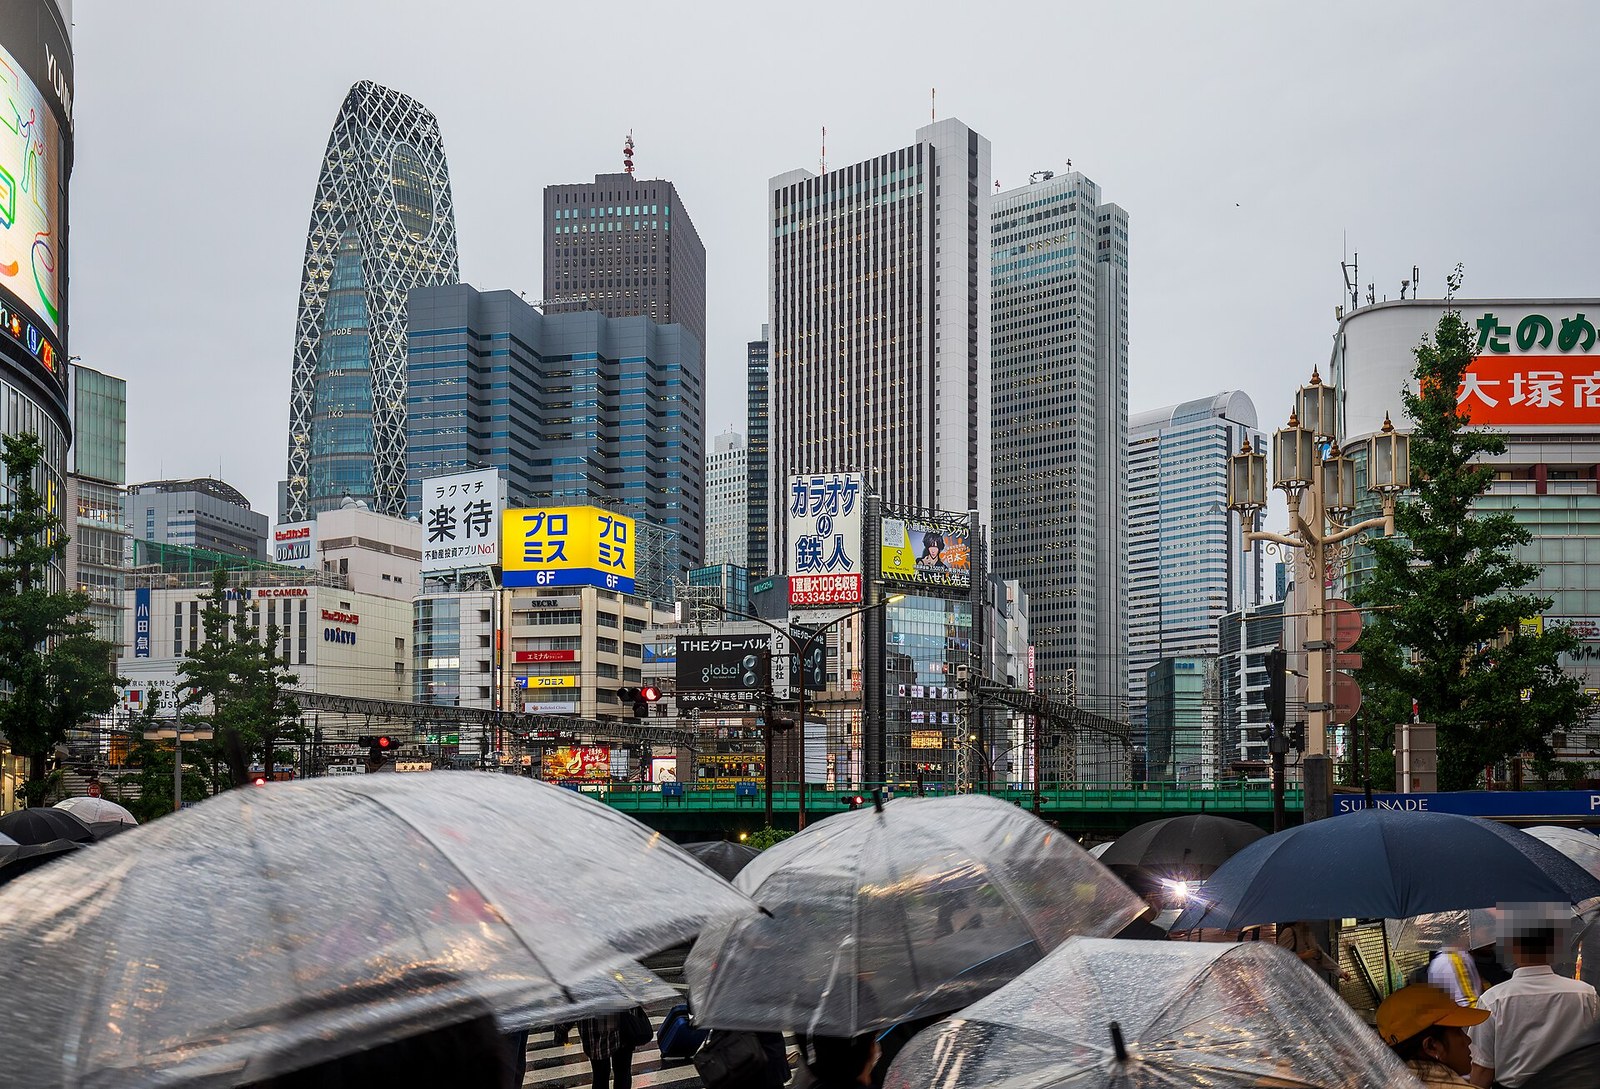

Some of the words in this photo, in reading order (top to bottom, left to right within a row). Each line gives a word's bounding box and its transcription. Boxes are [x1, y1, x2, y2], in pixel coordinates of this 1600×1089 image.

[331, 327, 352, 336] MODE
[1476, 313, 1600, 353] たのめ
[328, 368, 345, 377] HAL
[435, 480, 484, 499] ラクマチ
[790, 474, 859, 518] カラオケ
[427, 499, 493, 543] 楽待
[523, 511, 568, 538] プロ
[598, 515, 627, 544] プロ
[816, 513, 833, 539] の
[276, 544, 309, 561] ODAKYU
[523, 540, 568, 563] ミス
[598, 541, 627, 569] ミス
[795, 534, 854, 573] 鉄人
[536, 571, 556, 584] 6F
[606, 573, 619, 588] 6F
[792, 575, 858, 592] 1室最大100名収容
[914, 570, 970, 587] たいせい先生
[257, 589, 272, 597] BIC
[273, 588, 308, 597] CAMERA
[792, 590, 858, 602] 03-3345-6430
[136, 603, 149, 657] 小田急
[324, 627, 356, 645] ODAKYU
[538, 678, 564, 686] プロミス
[701, 664, 740, 683] global
[1340, 799, 1428, 812] SUNADE
